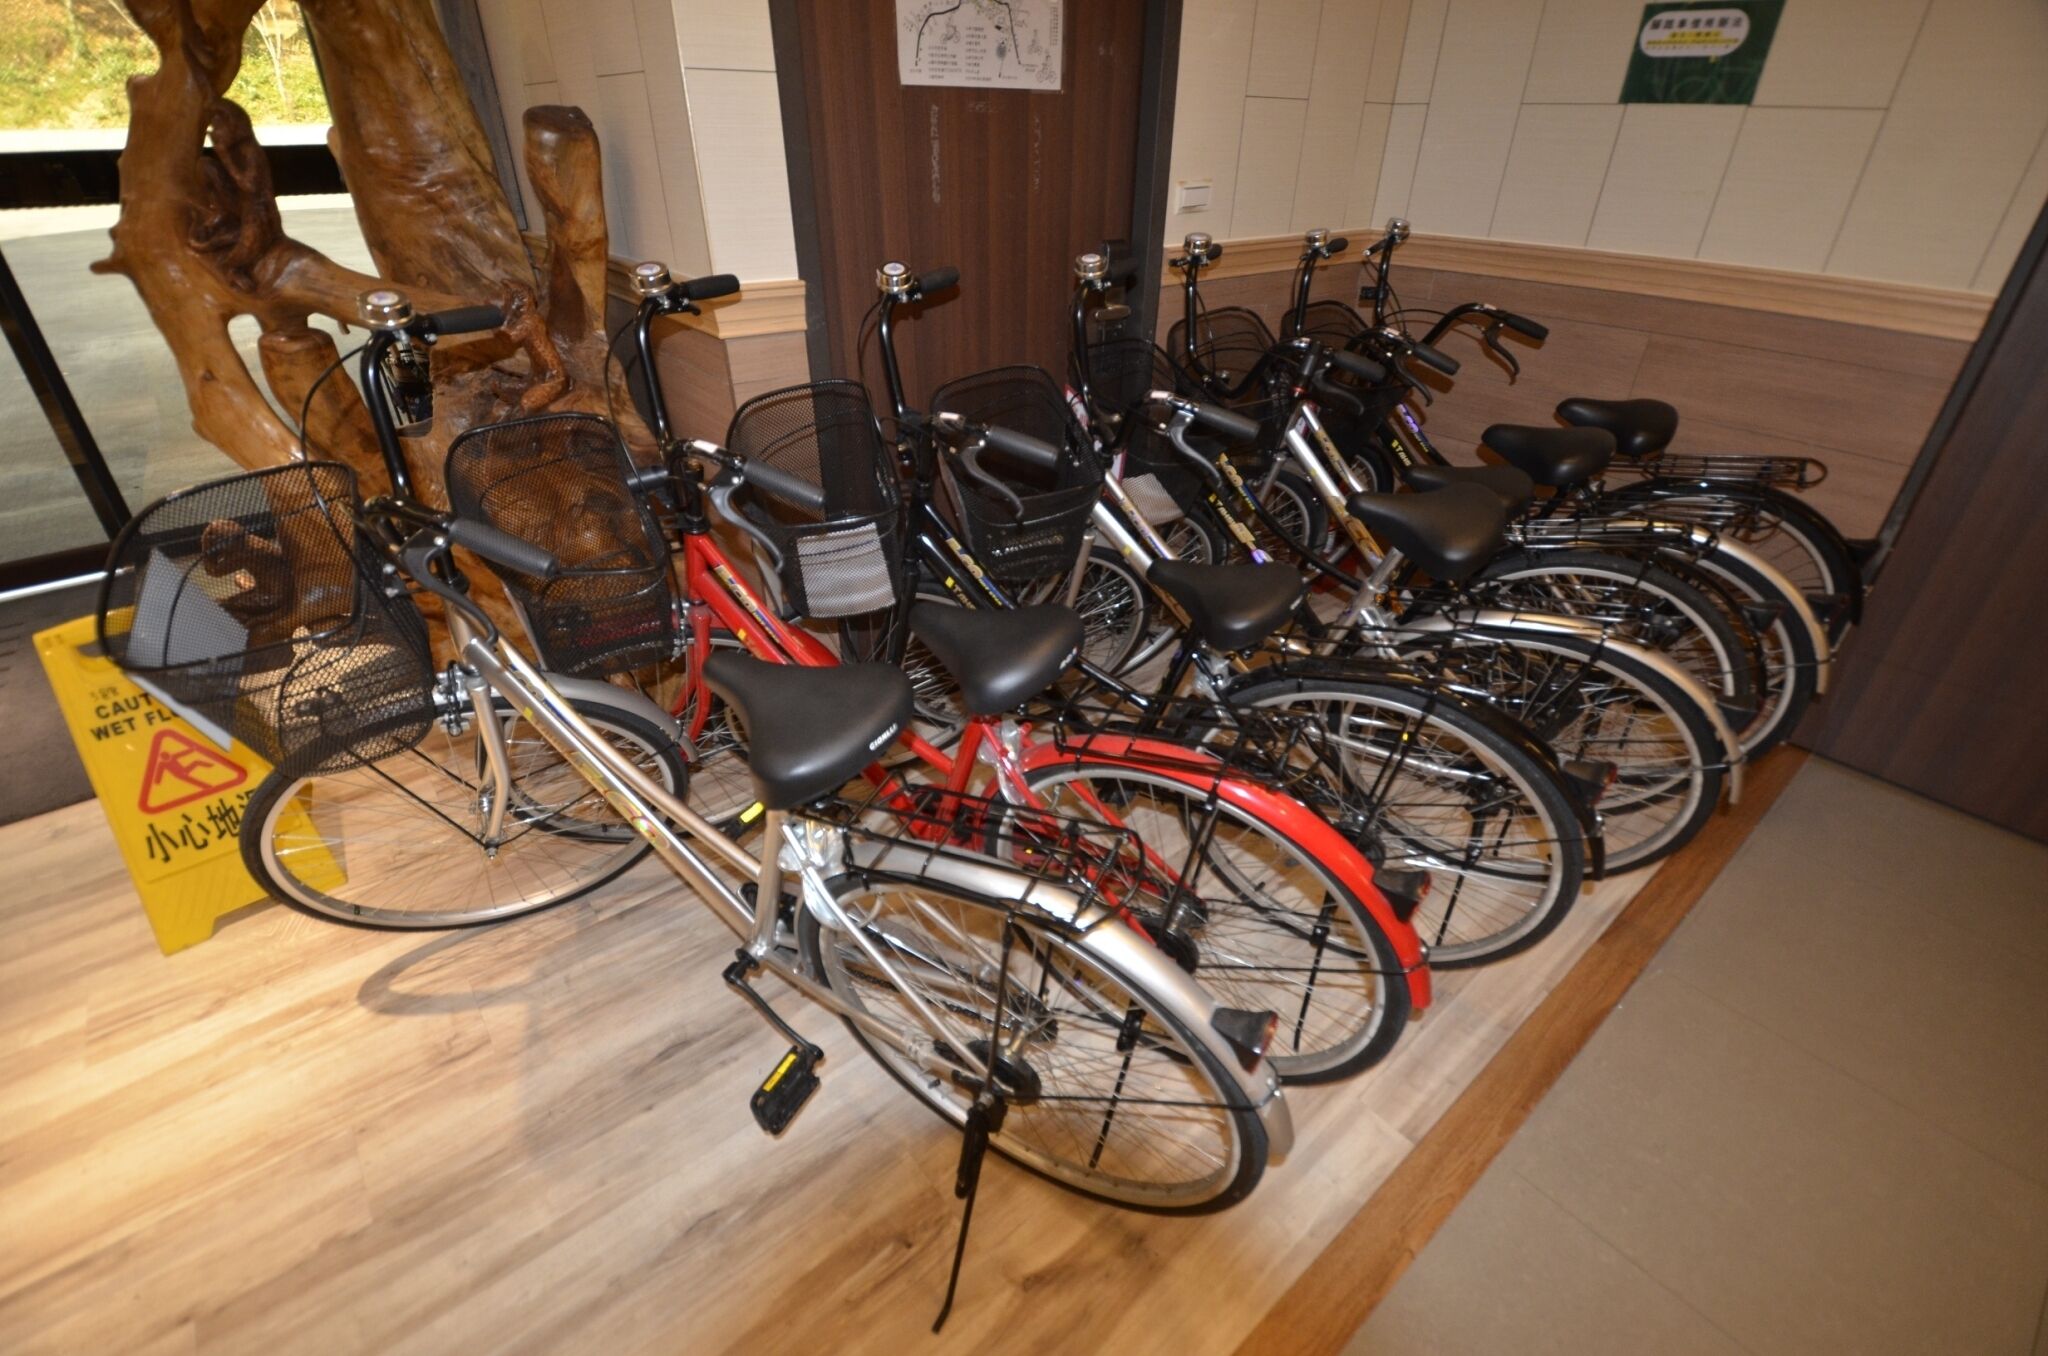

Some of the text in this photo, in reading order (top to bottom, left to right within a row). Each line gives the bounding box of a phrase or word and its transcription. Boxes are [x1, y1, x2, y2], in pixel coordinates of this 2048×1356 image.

[95, 692, 153, 720] CAUT
[90, 717, 136, 741] WET
[145, 788, 256, 862] 小心地
